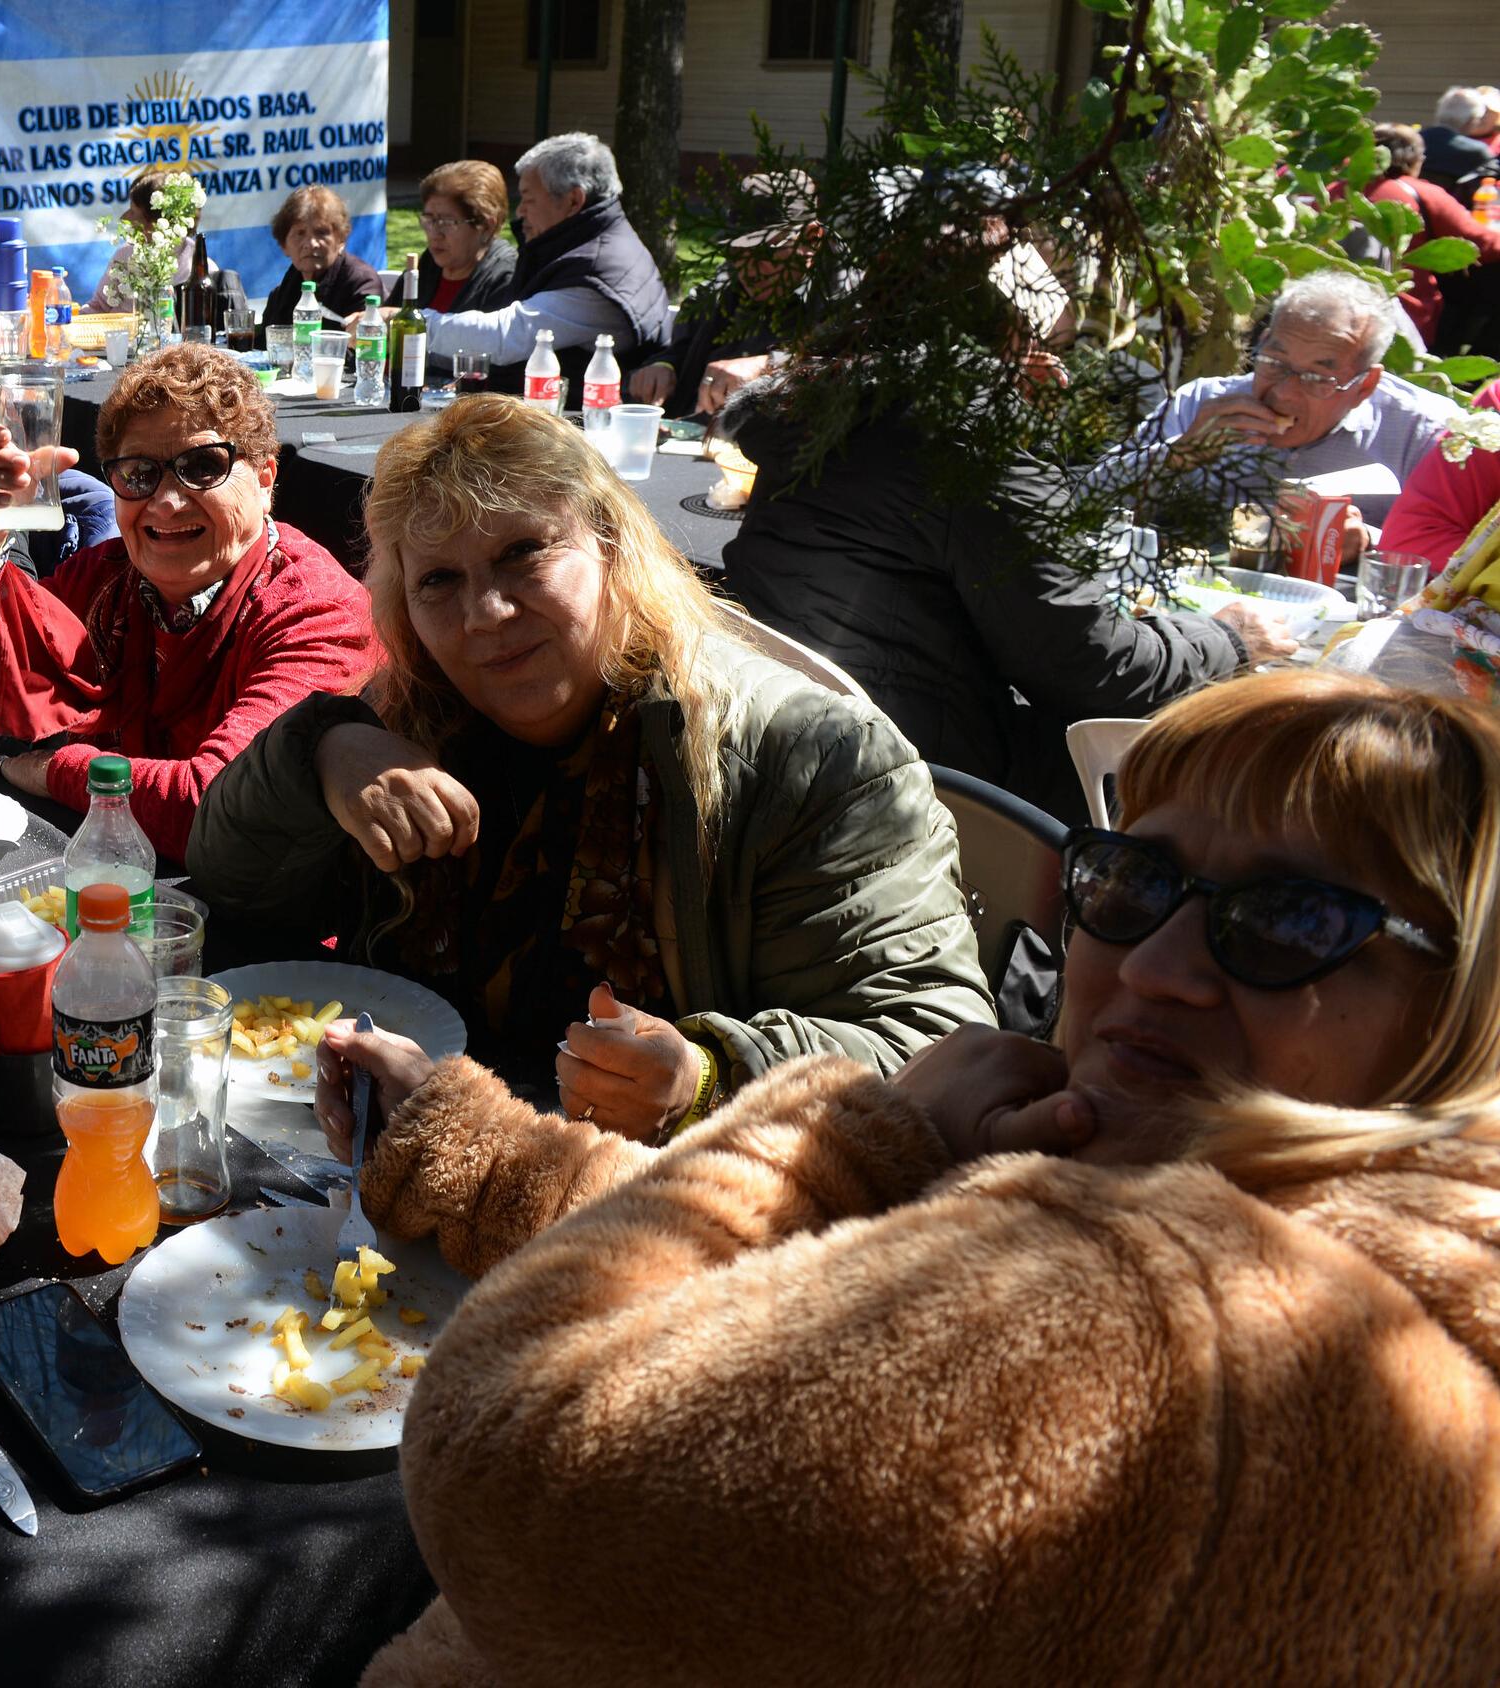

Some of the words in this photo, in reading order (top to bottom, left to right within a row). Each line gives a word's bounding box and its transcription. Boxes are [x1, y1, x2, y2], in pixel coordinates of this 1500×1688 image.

[18, 106, 81, 133] CLUB
[88, 102, 120, 129] DE
[125, 96, 251, 127] JUBILADOS
[258, 91, 316, 118] BASA.
[30, 143, 72, 172] LAS
[79, 138, 181, 168] GRACIAS
[188, 134, 217, 160] AL
[223, 133, 256, 158] SR.
[263, 127, 314, 155] RAUL
[319, 121, 384, 149] OLMOS
[266, 165, 282, 191] Y
[69, 1042, 118, 1065] FANTA
